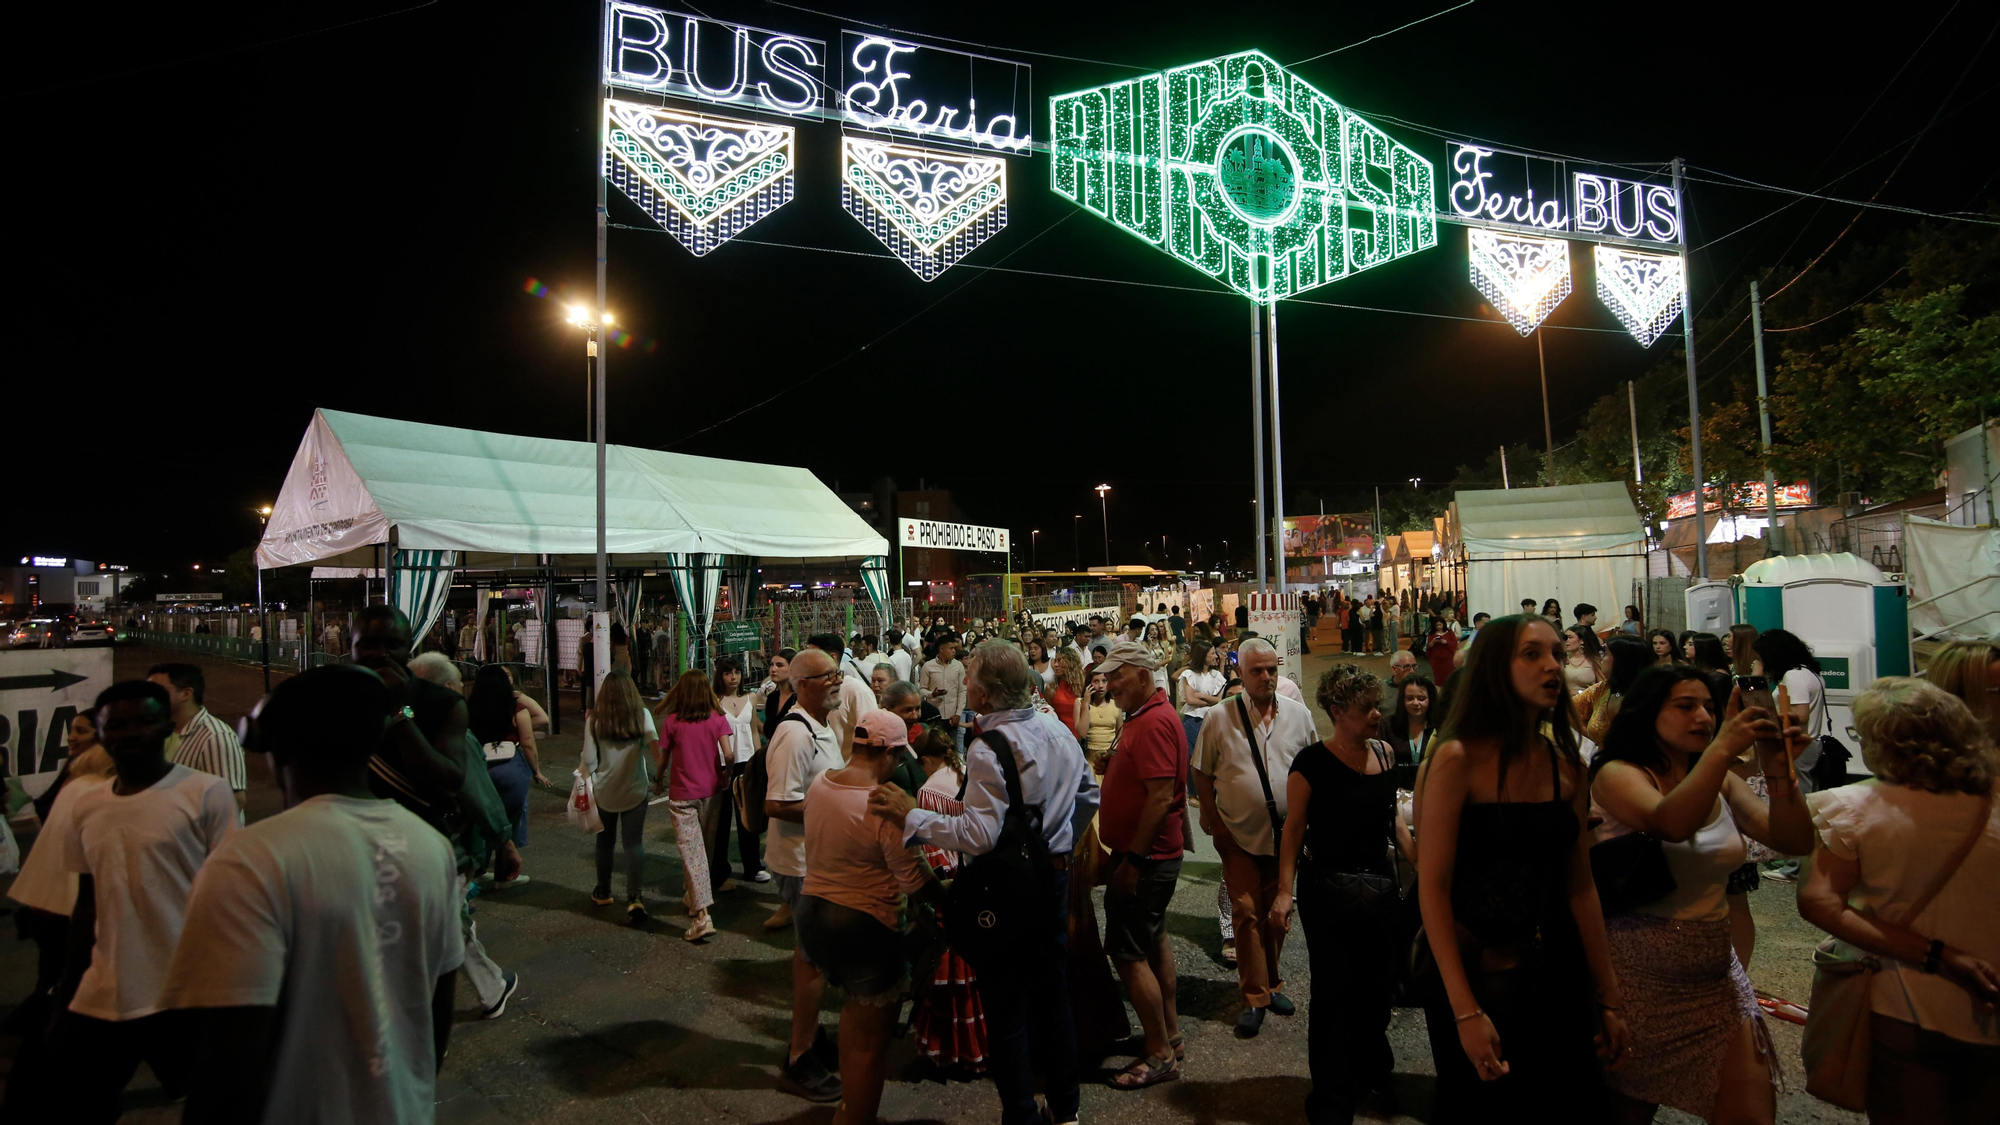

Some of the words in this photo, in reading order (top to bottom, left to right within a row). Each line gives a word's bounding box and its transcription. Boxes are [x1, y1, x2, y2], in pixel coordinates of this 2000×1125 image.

[609, 3, 819, 113] BUS
[845, 36, 1030, 149] Feria
[1450, 144, 1568, 229] Feria
[1575, 172, 1679, 242] BUS
[919, 522, 965, 547] PROHIBIDO
[966, 526, 976, 548] EL
[977, 527, 996, 550] PASO
[1036, 615, 1064, 634] CCESO
[1286, 647, 1300, 657] FERIA
